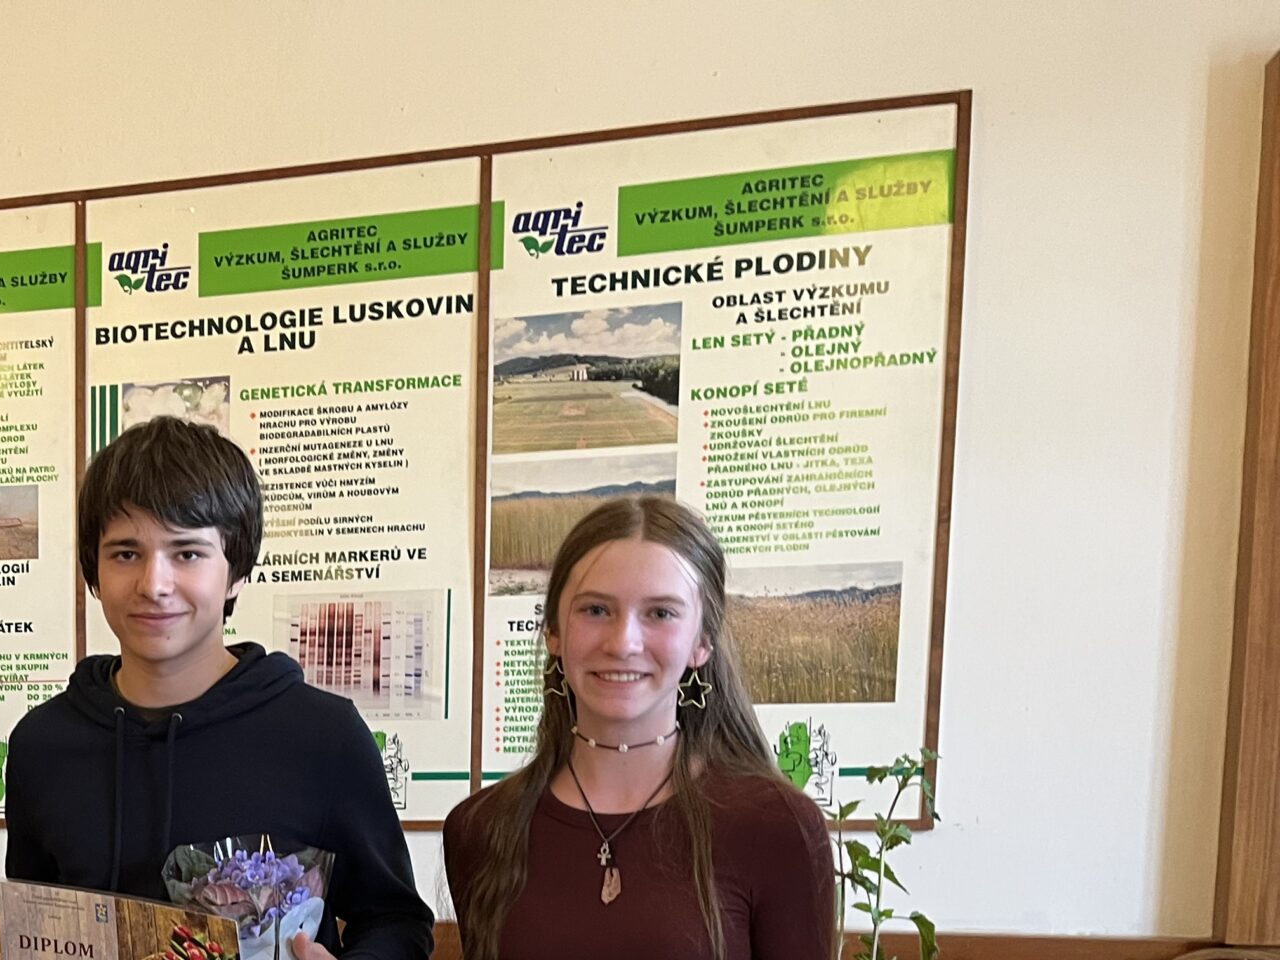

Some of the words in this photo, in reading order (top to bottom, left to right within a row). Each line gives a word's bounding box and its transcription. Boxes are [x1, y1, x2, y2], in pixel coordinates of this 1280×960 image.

[742, 174, 824, 195] AGRITEC
[635, 205, 718, 226] VÝZKUM,
[725, 187, 830, 215] ŠLECHTĚNÍ
[837, 189, 848, 202] A
[856, 180, 932, 201] SLUŽBY
[512, 201, 583, 236] agri
[714, 215, 804, 237] ŠUMPERK
[812, 213, 854, 227] s.r.o.
[307, 225, 378, 242] AGRITEC
[555, 224, 607, 256] tec
[108, 242, 169, 274] agri
[214, 251, 285, 268] VÝZKUM,
[291, 238, 380, 261] ŠLECHTĚNÍ
[387, 240, 396, 252] A
[403, 233, 468, 250] SLUŽBY
[10, 272, 67, 287] SLUŽBY
[145, 263, 190, 292] tec
[282, 262, 358, 280] ŠUMPERK
[365, 261, 401, 271] s.r.o.
[551, 255, 724, 297] TECHNICKÉ
[735, 245, 873, 279] PLODINY
[713, 291, 787, 309] OBLAST
[793, 281, 890, 303] VÝZKUMU
[95, 308, 323, 345] BIOTECHNOLOGIE
[333, 294, 473, 324] LUSKOVIN
[736, 313, 747, 325] A
[754, 298, 861, 323] ŠLECHTĚNÍ
[238, 336, 255, 354] A
[264, 330, 316, 352] LNU
[692, 336, 725, 350] LEN
[731, 328, 775, 347] SETÝ
[792, 321, 865, 342] PŘADNÝ
[791, 337, 862, 358] OLEJNÝ
[790, 348, 937, 374] OLEJNOPŘADNÝ
[240, 381, 327, 401] GENETICKÁ
[333, 375, 462, 395] TRANSFORMACE
[691, 381, 759, 401] KONOPÍ
[764, 376, 808, 395] SETÉ
[260, 407, 314, 419] MODIFIKACE
[317, 405, 354, 415] ŠKROBU
[365, 401, 408, 412] AMYLÓZY
[259, 428, 353, 440] BIODEGRADABILNÍCH
[355, 424, 390, 435] PLASTŮ
[260, 421, 296, 429] HRACHU
[299, 419, 316, 427] PRO
[320, 416, 357, 425] VÝROBU
[710, 429, 763, 440] ZKOUŠKY
[259, 445, 301, 454] INZERČNÍ
[303, 440, 363, 451] MUTAGENEZE
[376, 438, 394, 446] LNU
[265, 453, 334, 465] MORFOLOGICKÉ
[373, 449, 405, 458] ZMĚNY
[259, 468, 270, 476] VE
[273, 464, 311, 475] SKLADBĚ
[314, 462, 362, 472] MASTNÝCH
[365, 460, 402, 470] KYSELIN
[308, 490, 335, 499] VIRŮM
[348, 487, 399, 497] HOUBOVÝM
[316, 479, 337, 488] VŮČI
[340, 477, 376, 487] HMYZÍM
[741, 498, 784, 509] KONOPÍ
[298, 517, 330, 527] PODÍLU
[333, 515, 373, 524] SIRNÝCH
[336, 526, 384, 535] SEMENECH
[387, 523, 426, 532] HRACHU
[324, 545, 401, 564] MARKERŮ
[407, 548, 427, 560] VE
[257, 571, 266, 583] A
[272, 564, 380, 582] SEMENÁŘSTVÍ
[23, 652, 68, 660] KRMNÝCH
[19, 935, 94, 958] DIPLOM
